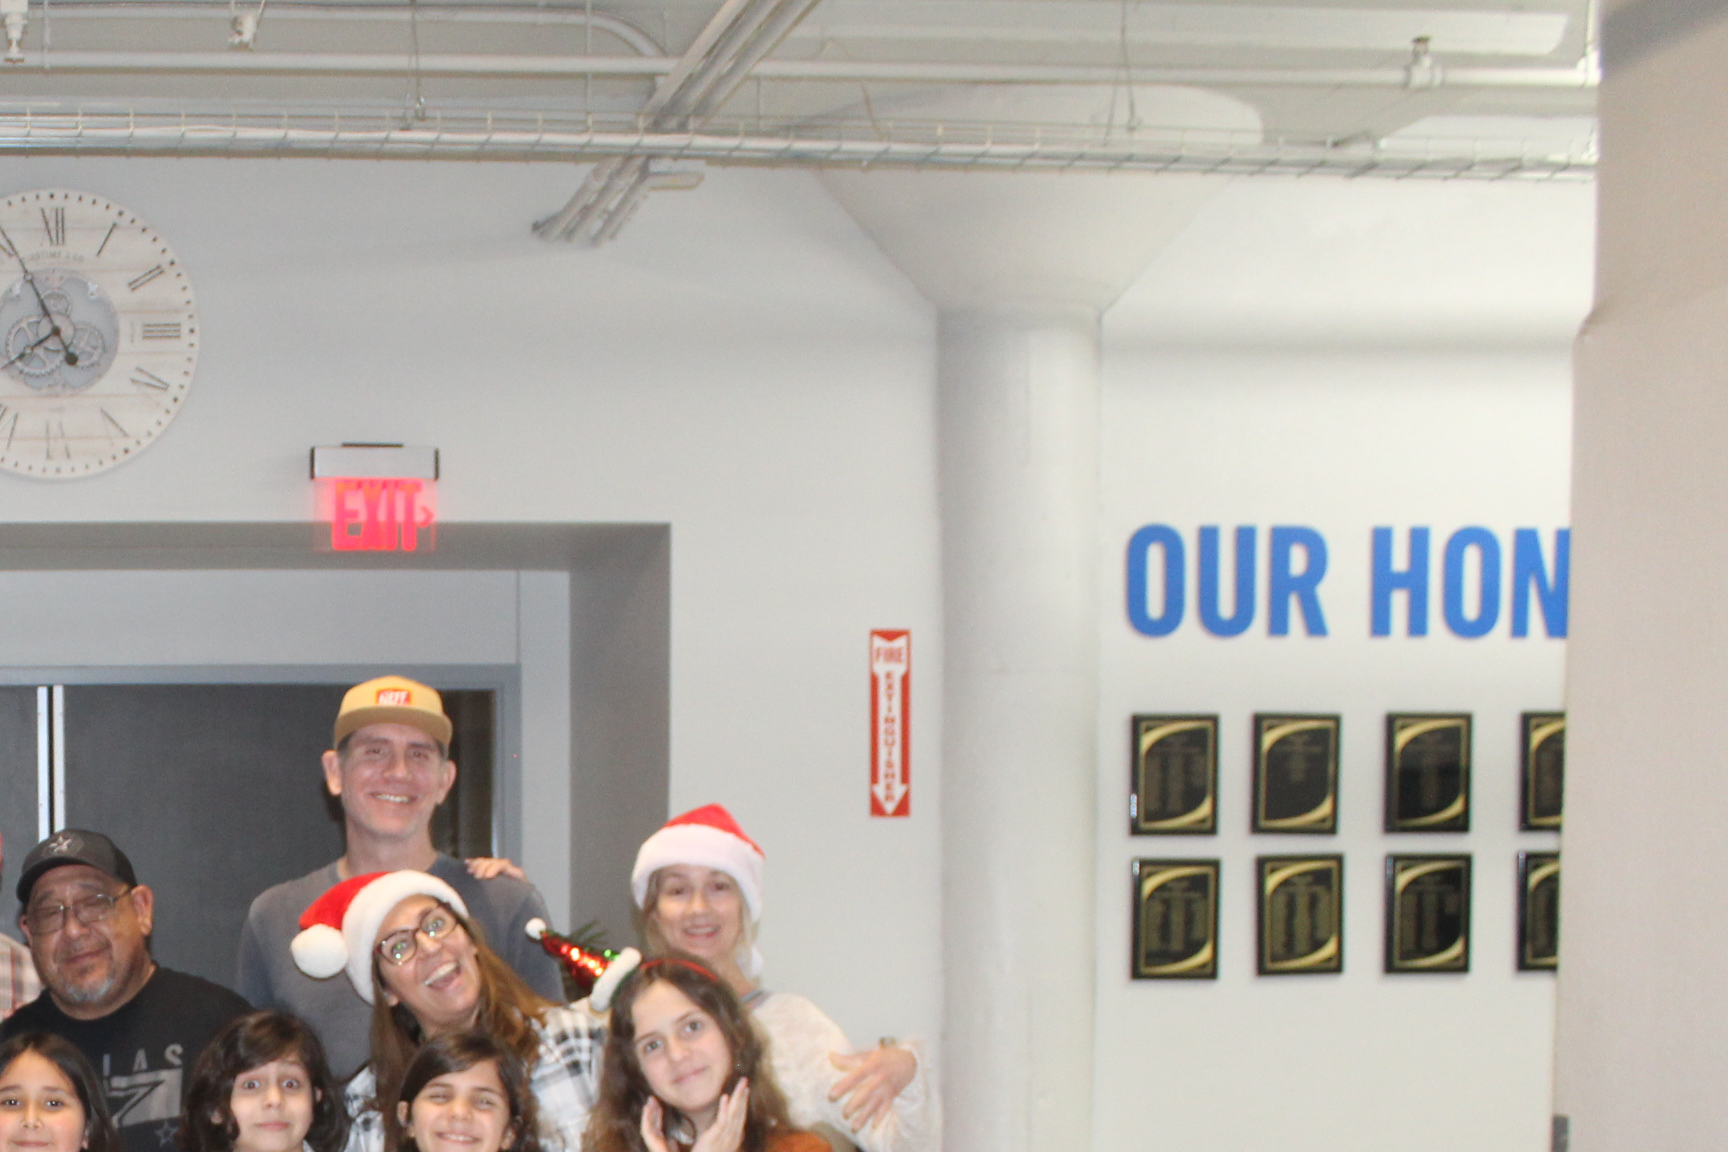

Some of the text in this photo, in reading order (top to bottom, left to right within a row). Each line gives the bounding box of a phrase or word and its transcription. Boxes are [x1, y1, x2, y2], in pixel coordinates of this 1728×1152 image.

[332, 480, 423, 551] EXIT
[1125, 523, 1571, 640] OUR HON
